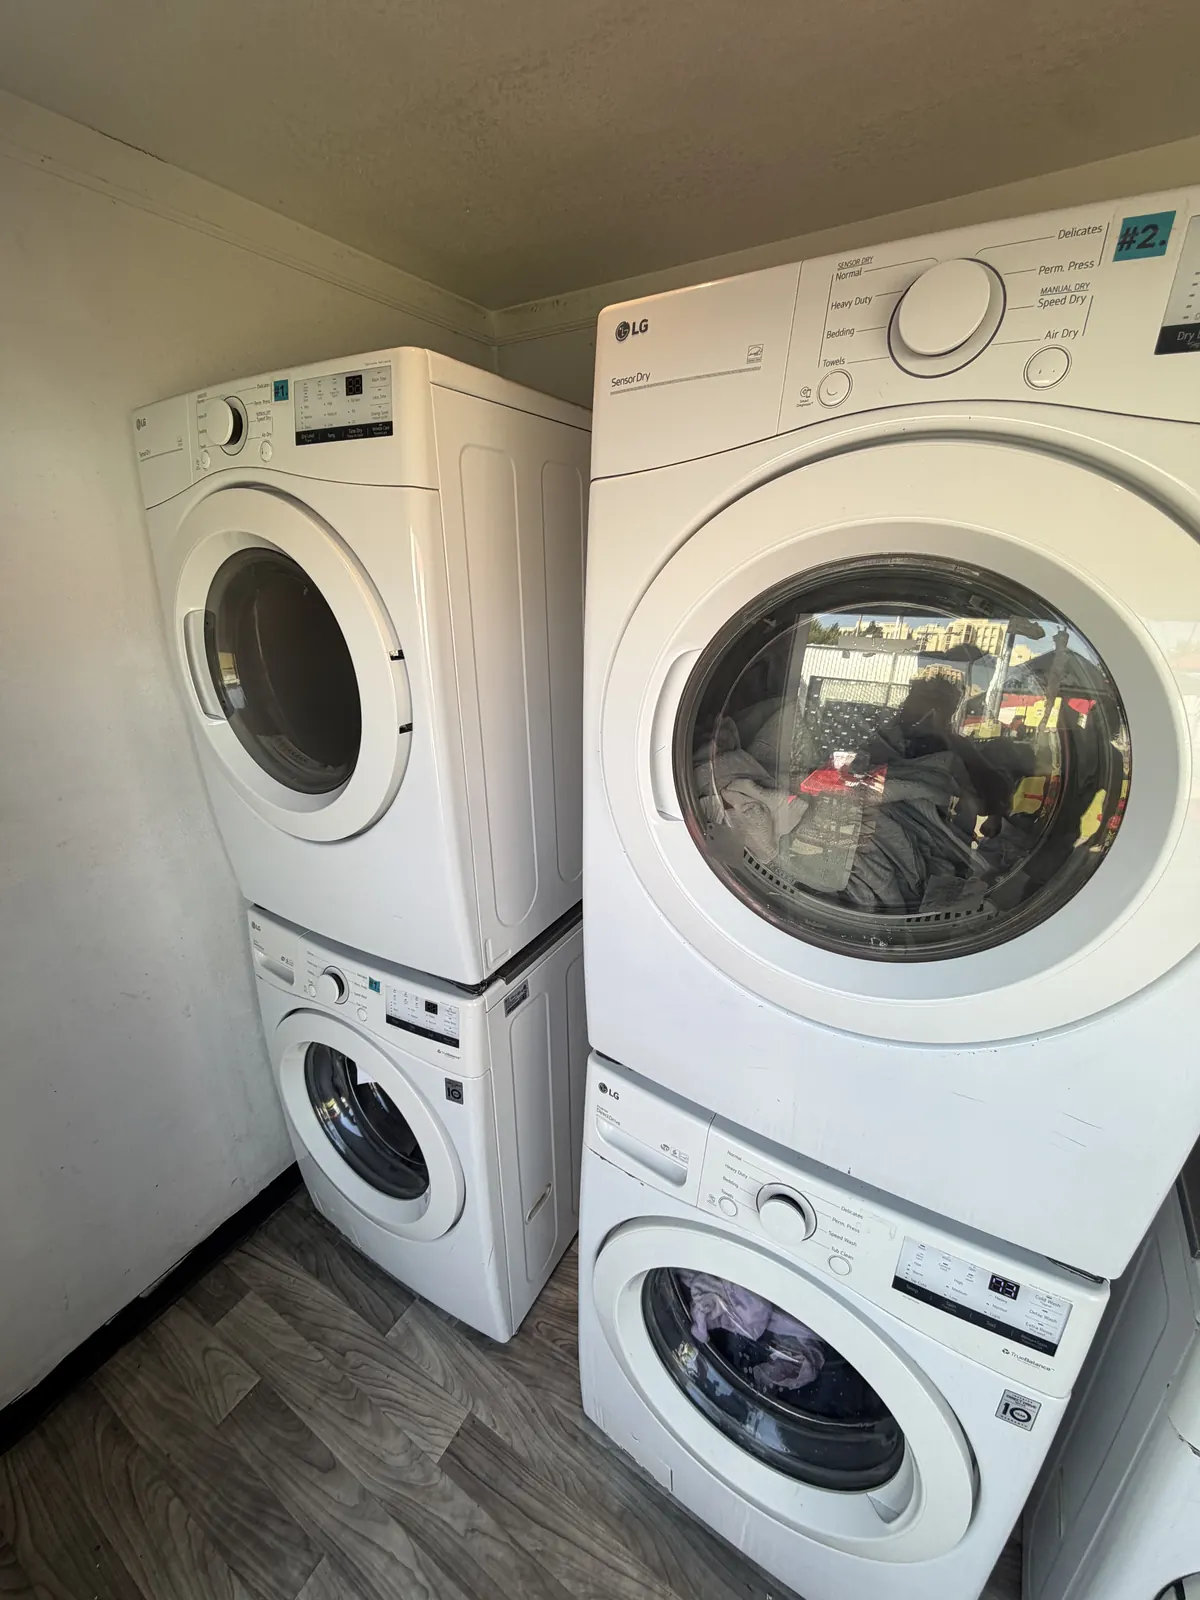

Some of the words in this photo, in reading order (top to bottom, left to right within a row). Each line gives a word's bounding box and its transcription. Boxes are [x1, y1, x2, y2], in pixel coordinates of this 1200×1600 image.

[1057, 224, 1103, 240] Delicates
[1117, 223, 1167, 252] #2.
[837, 258, 861, 269] SENSOR
[861, 255, 874, 265] DRY
[1038, 263, 1065, 275] Perm.
[1068, 260, 1095, 271] Press
[835, 267, 863, 281] Normal
[1040, 284, 1072, 295] MANUAL
[1074, 282, 1091, 291] DRY
[830, 300, 853, 311] Heavy
[854, 295, 873, 306] Duty
[1037, 295, 1067, 309] Speed
[1068, 293, 1087, 306] Dry
[826, 327, 855, 340] Bedding
[1044, 329, 1059, 340] Air
[1061, 328, 1079, 340] Dry
[1176, 331, 1195, 342] Dry
[823, 356, 846, 368] Towels
[447, 1087, 462, 1100] 10
[726, 1150, 743, 1162] Normal
[724, 1163, 737, 1174] Heavy
[737, 1169, 748, 1179] Duty
[722, 1175, 739, 1189] Bedding
[721, 1188, 734, 1199] Towels
[840, 1205, 864, 1220] Delicates
[832, 1216, 846, 1228] Perm.
[846, 1223, 861, 1234] Press
[828, 1230, 844, 1241] Speed
[844, 1237, 857, 1247] Wash
[831, 1246, 840, 1255] Tub
[840, 1250, 854, 1260] Clean
[1035, 1294, 1047, 1304] Cold
[1047, 1298, 1061, 1308] Wash
[1029, 1309, 1043, 1319] Delay
[1043, 1315, 1058, 1324] Wash
[1025, 1321, 1039, 1331] Extra
[1002, 1402, 1032, 1423] 10
[1014, 1410, 1026, 1419] YEAR
